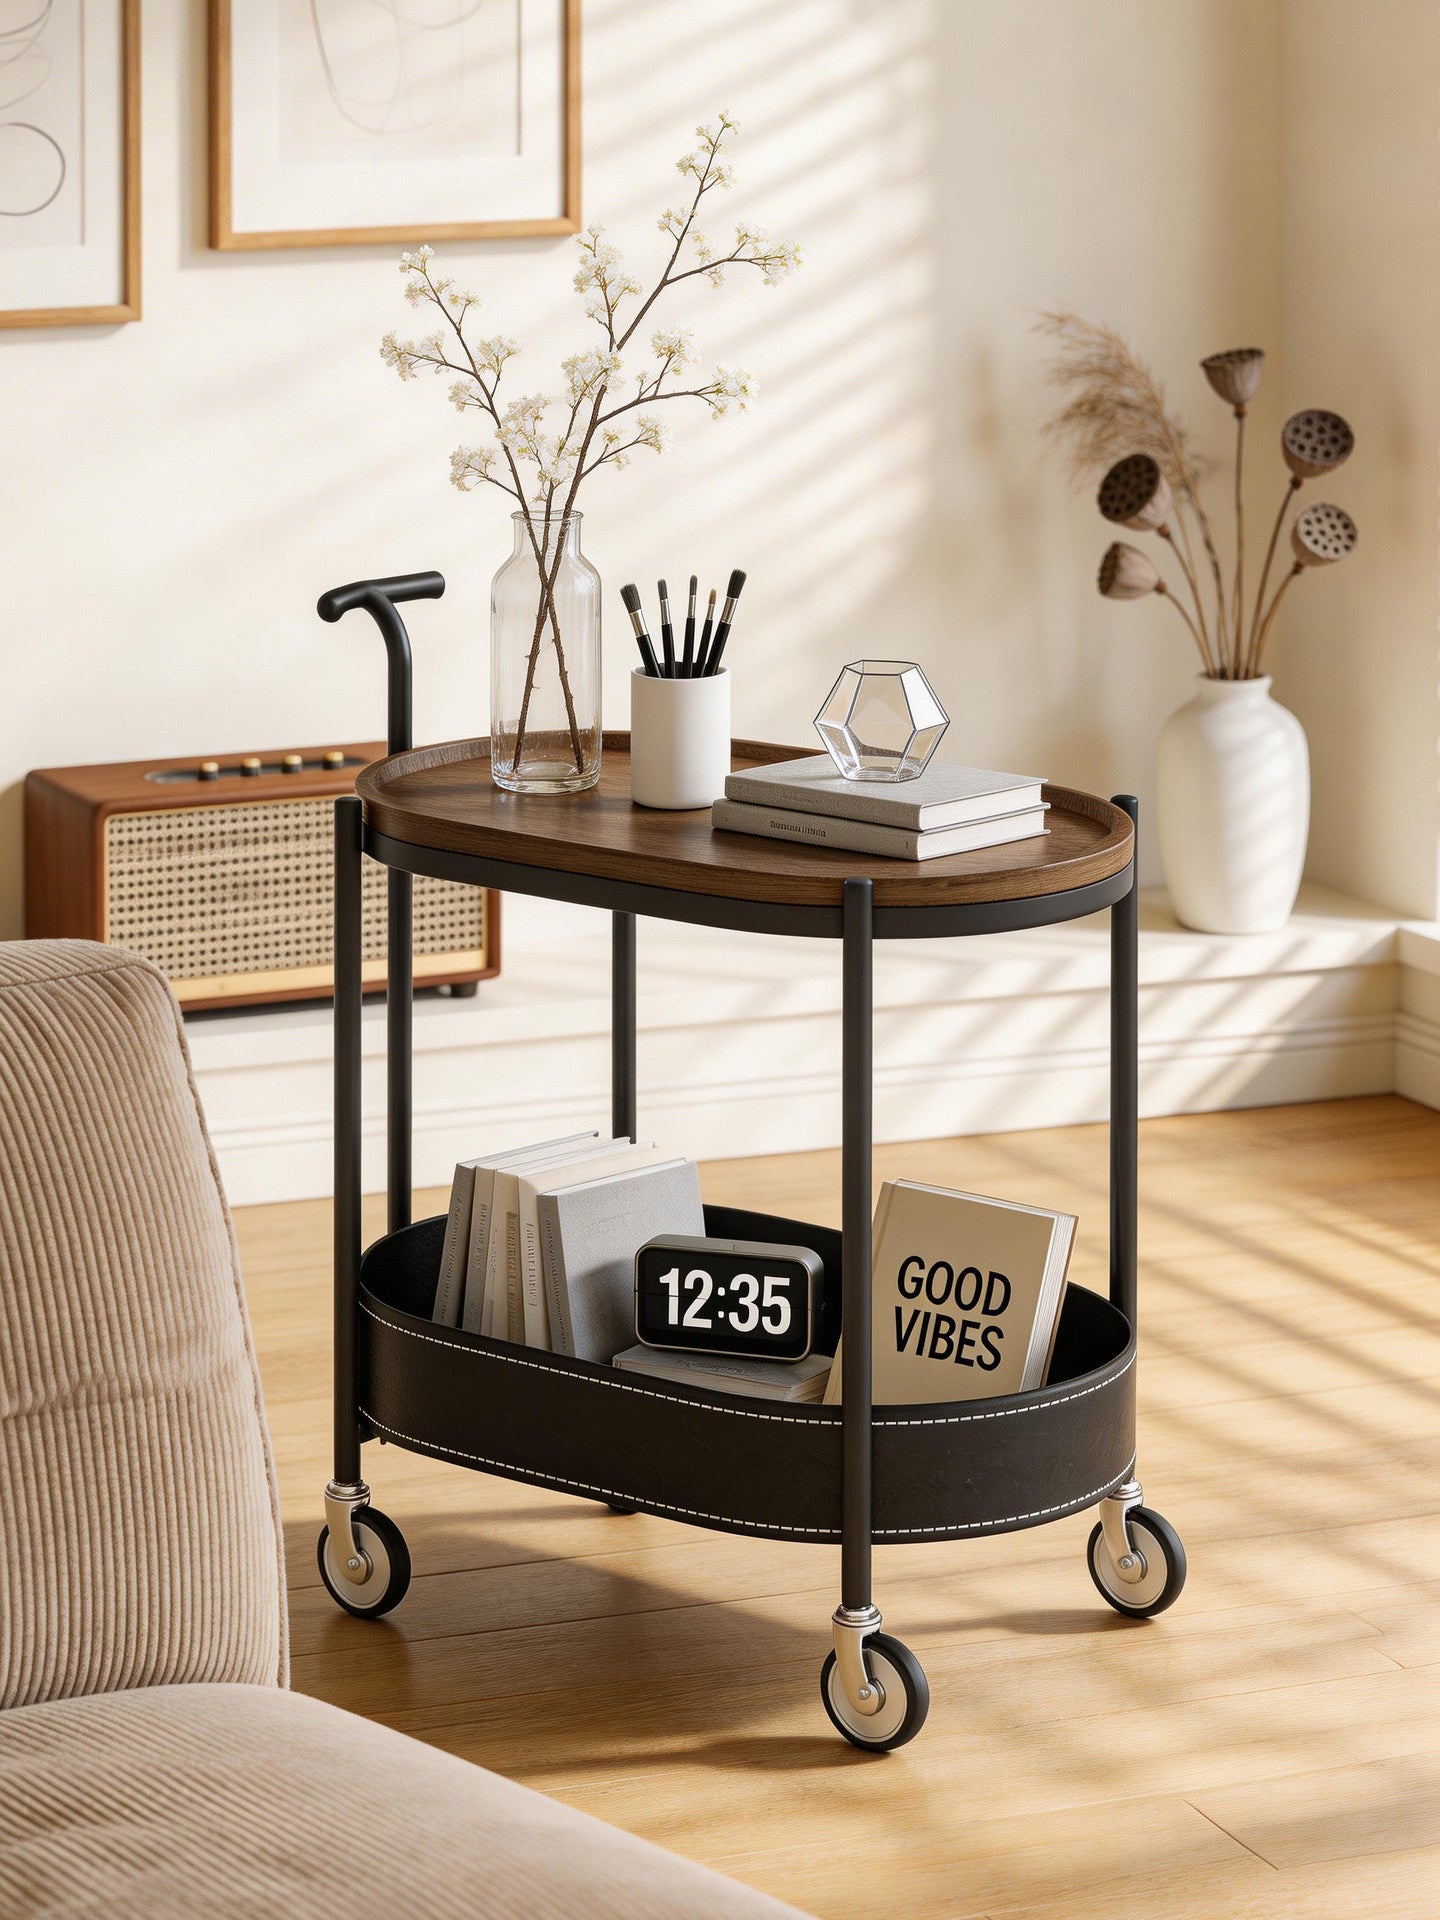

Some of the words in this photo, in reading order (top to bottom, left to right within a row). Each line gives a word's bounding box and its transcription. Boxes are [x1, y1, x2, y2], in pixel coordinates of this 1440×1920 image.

[658, 1267, 792, 1335] 12:35
[897, 1255, 1012, 1317] GOOD
[894, 1305, 1005, 1372] VIBES
